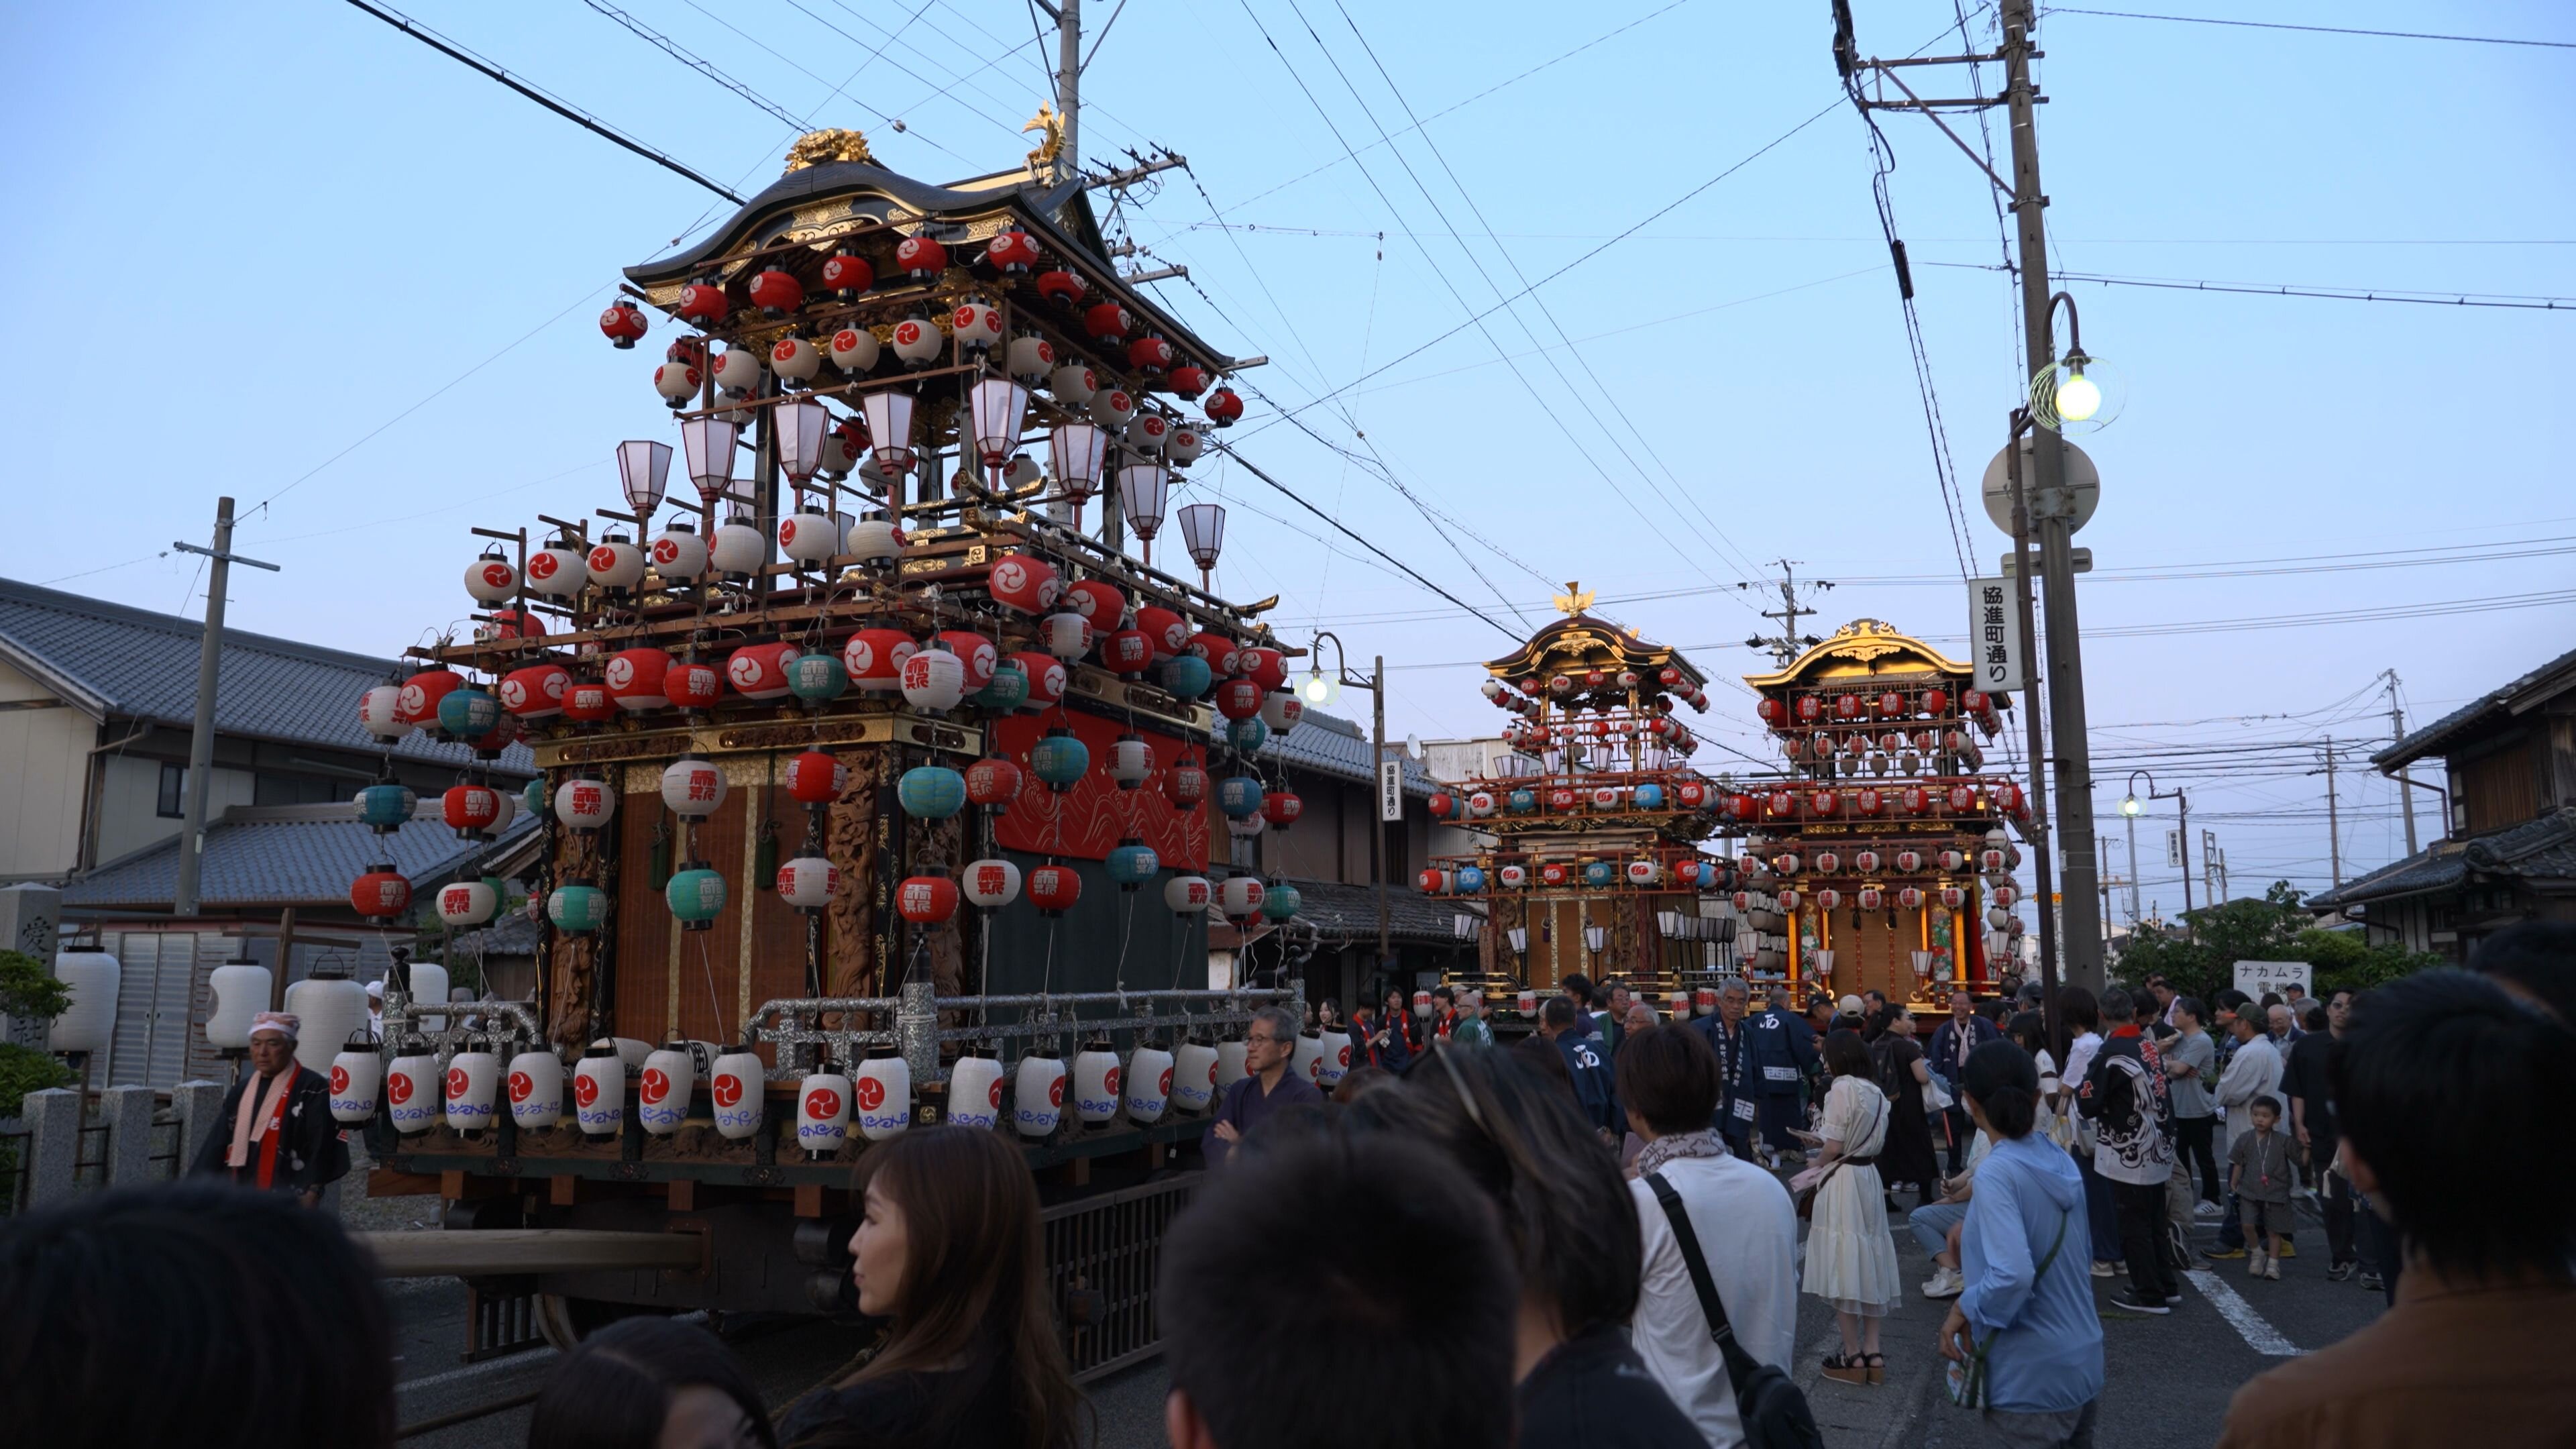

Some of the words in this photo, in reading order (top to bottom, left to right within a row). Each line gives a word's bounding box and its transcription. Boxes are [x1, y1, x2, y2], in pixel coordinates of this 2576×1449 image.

[1982, 586, 2008, 683] 協進町通り
[1386, 765, 1395, 816] 協進町通り
[2239, 965, 2303, 979] ナカムラ
[2257, 981, 2288, 994] 電機
